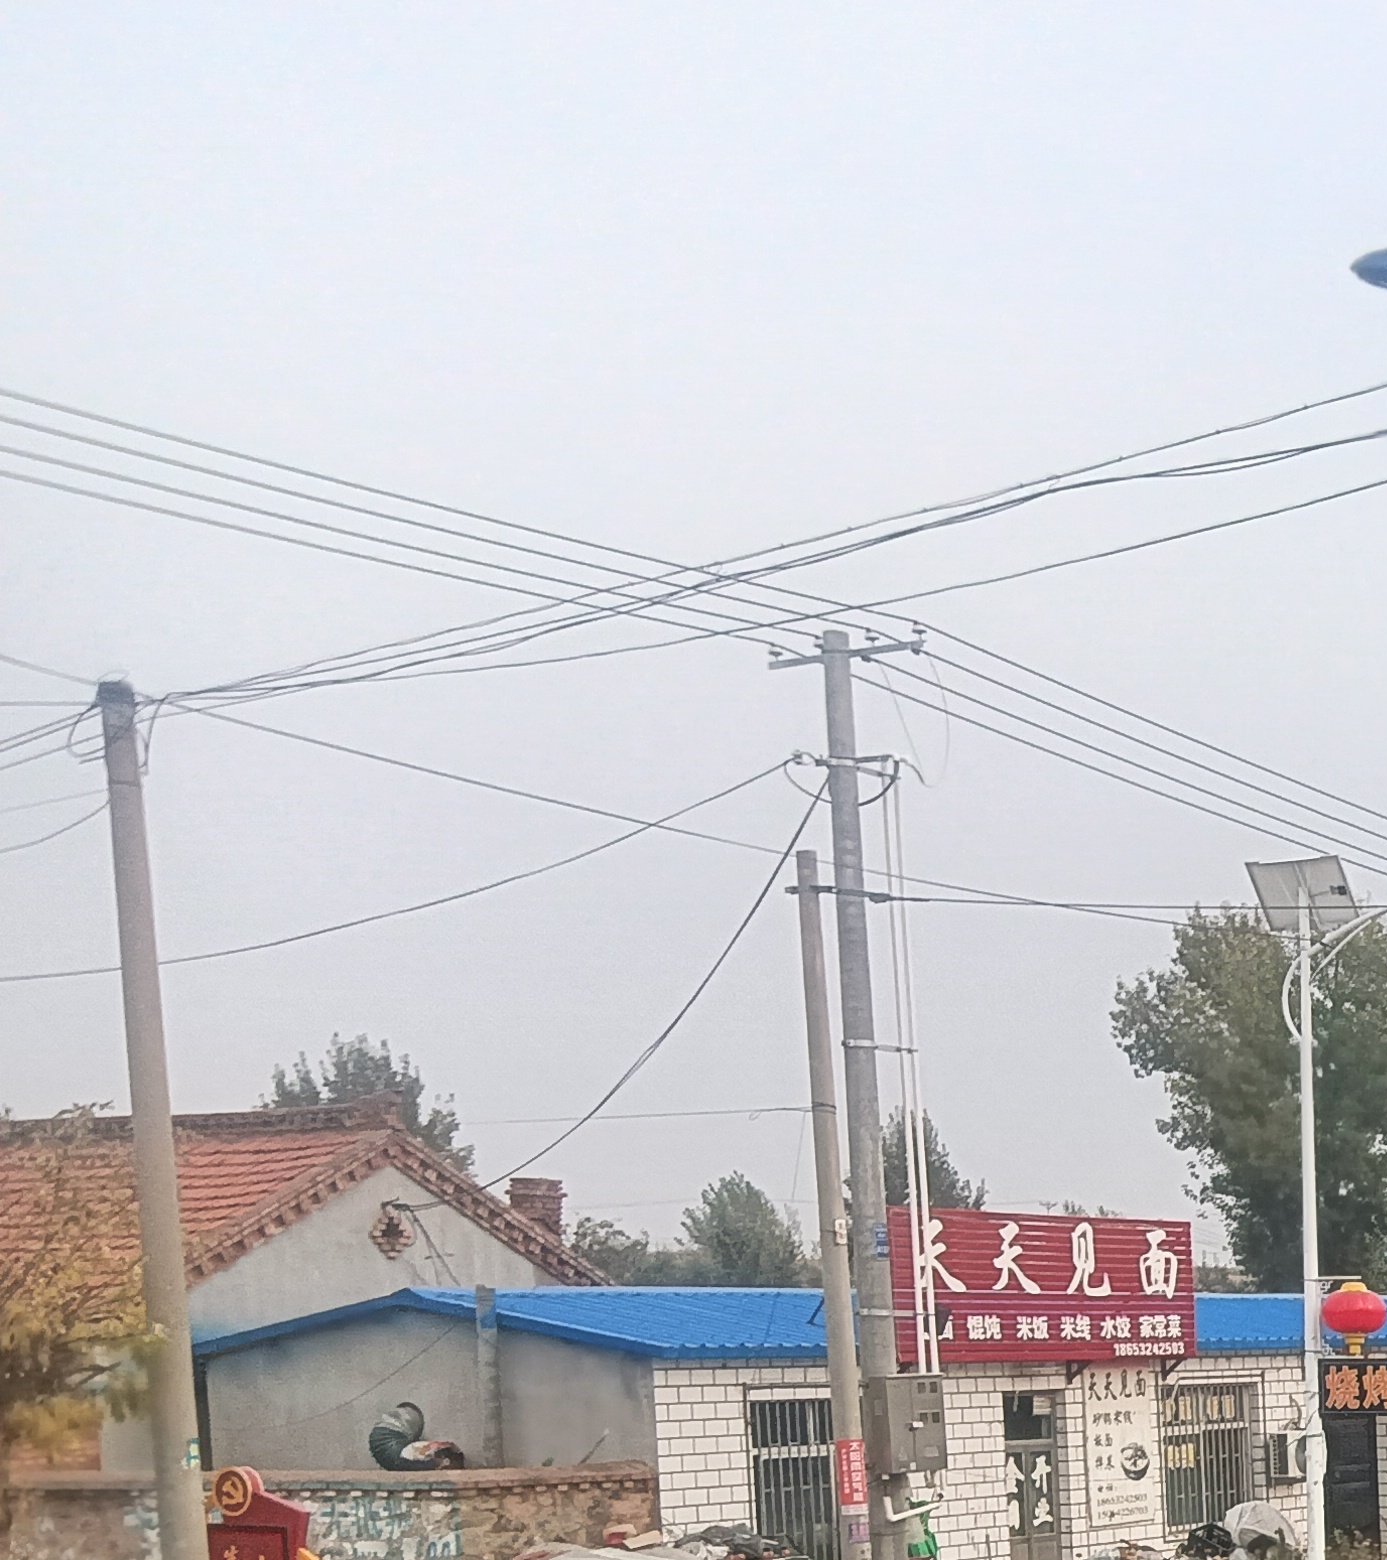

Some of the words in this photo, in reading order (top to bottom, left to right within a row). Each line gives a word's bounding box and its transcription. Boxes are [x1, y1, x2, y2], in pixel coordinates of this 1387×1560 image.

[966, 1315, 1001, 1340] 馄饨
[1016, 1315, 1049, 1340] 米饭
[1060, 1314, 1091, 1340] 米线
[1100, 1315, 1131, 1339] 水饺
[1139, 1314, 1182, 1339] 家常菜
[1088, 1369, 1146, 1401] 天天见面
